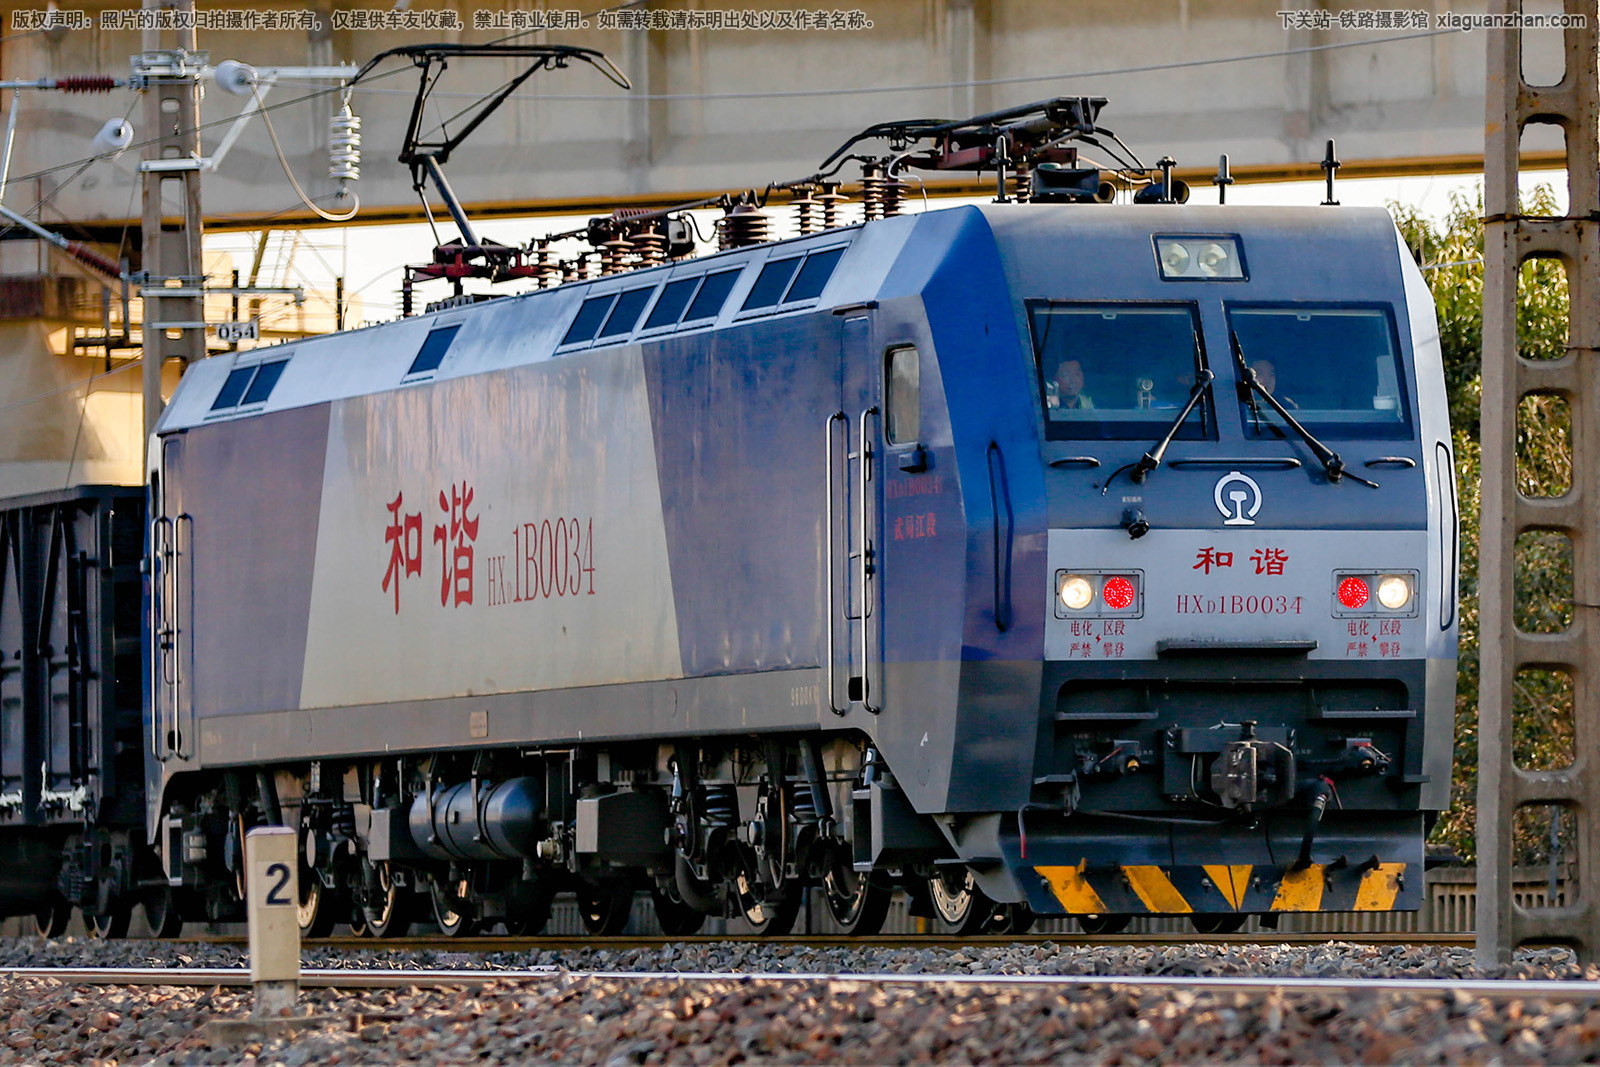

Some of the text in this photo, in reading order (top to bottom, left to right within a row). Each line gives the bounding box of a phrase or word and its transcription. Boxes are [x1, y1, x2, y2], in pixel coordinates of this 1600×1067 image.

[218, 326, 255, 341] 054
[382, 480, 595, 615] 和谐 HXD1B0034
[1192, 546, 1289, 575] 和谐
[1176, 594, 1303, 614] HXD1B0034
[266, 863, 292, 905] 2
